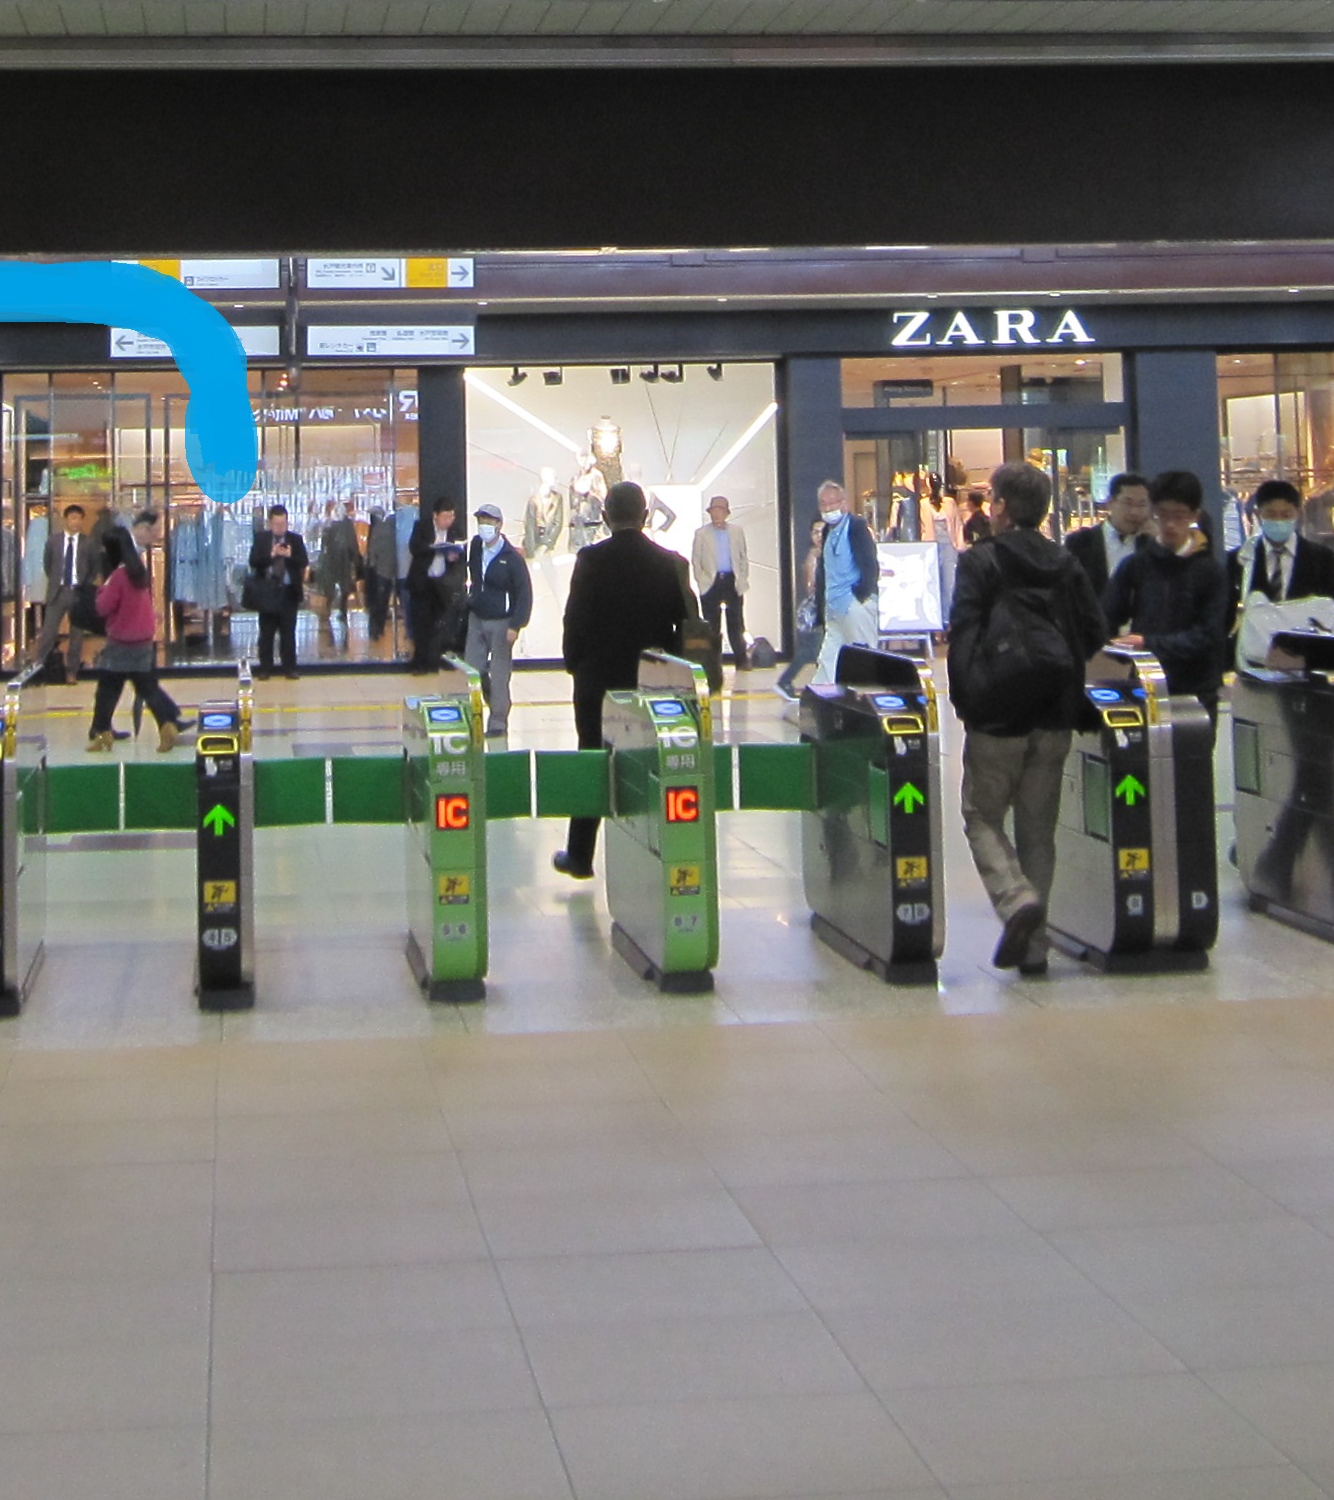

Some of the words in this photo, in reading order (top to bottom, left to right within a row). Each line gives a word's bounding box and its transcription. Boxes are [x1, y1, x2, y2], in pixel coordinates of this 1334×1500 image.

[891, 309, 1096, 347] ZARA
[431, 734, 468, 755] IC
[437, 797, 469, 829] IC
[668, 789, 699, 822] IC
